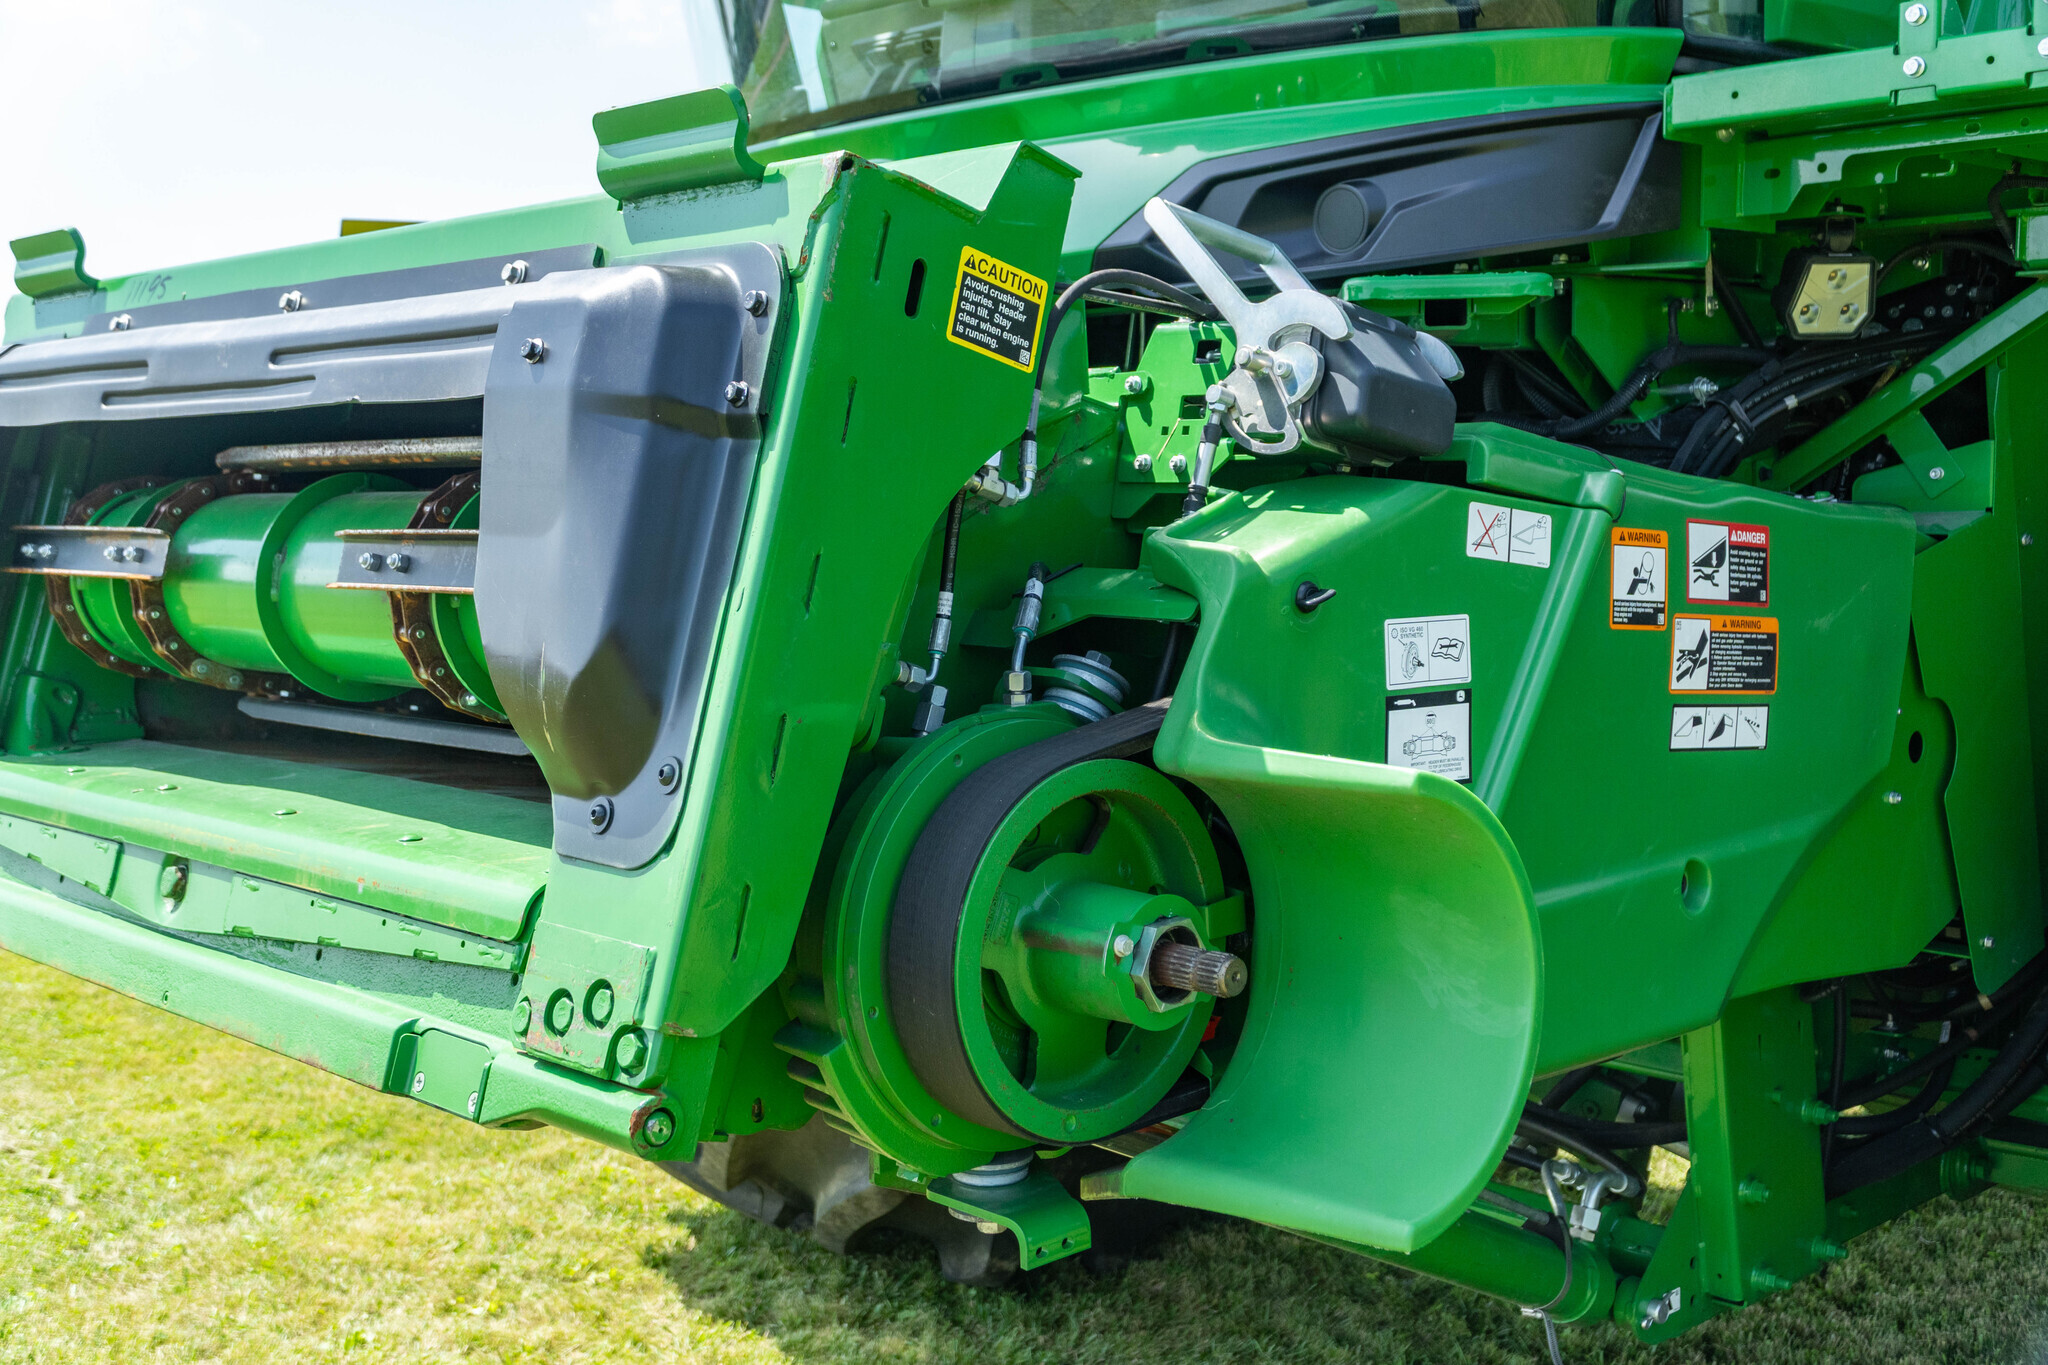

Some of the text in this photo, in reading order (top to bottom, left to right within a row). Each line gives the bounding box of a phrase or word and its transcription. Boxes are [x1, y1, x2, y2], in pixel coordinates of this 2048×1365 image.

[965, 276, 1025, 311] Avoid crushing
[977, 259, 1043, 299] CAUTION
[960, 301, 1012, 330] can tilt. Stay
[963, 287, 1027, 322] injuries. Header
[956, 322, 999, 349] is running.
[958, 312, 1029, 348] clear when engine
[1627, 531, 1661, 543] WARNING
[1737, 530, 1766, 544] DANGER
[1730, 619, 1762, 629] WARNING
